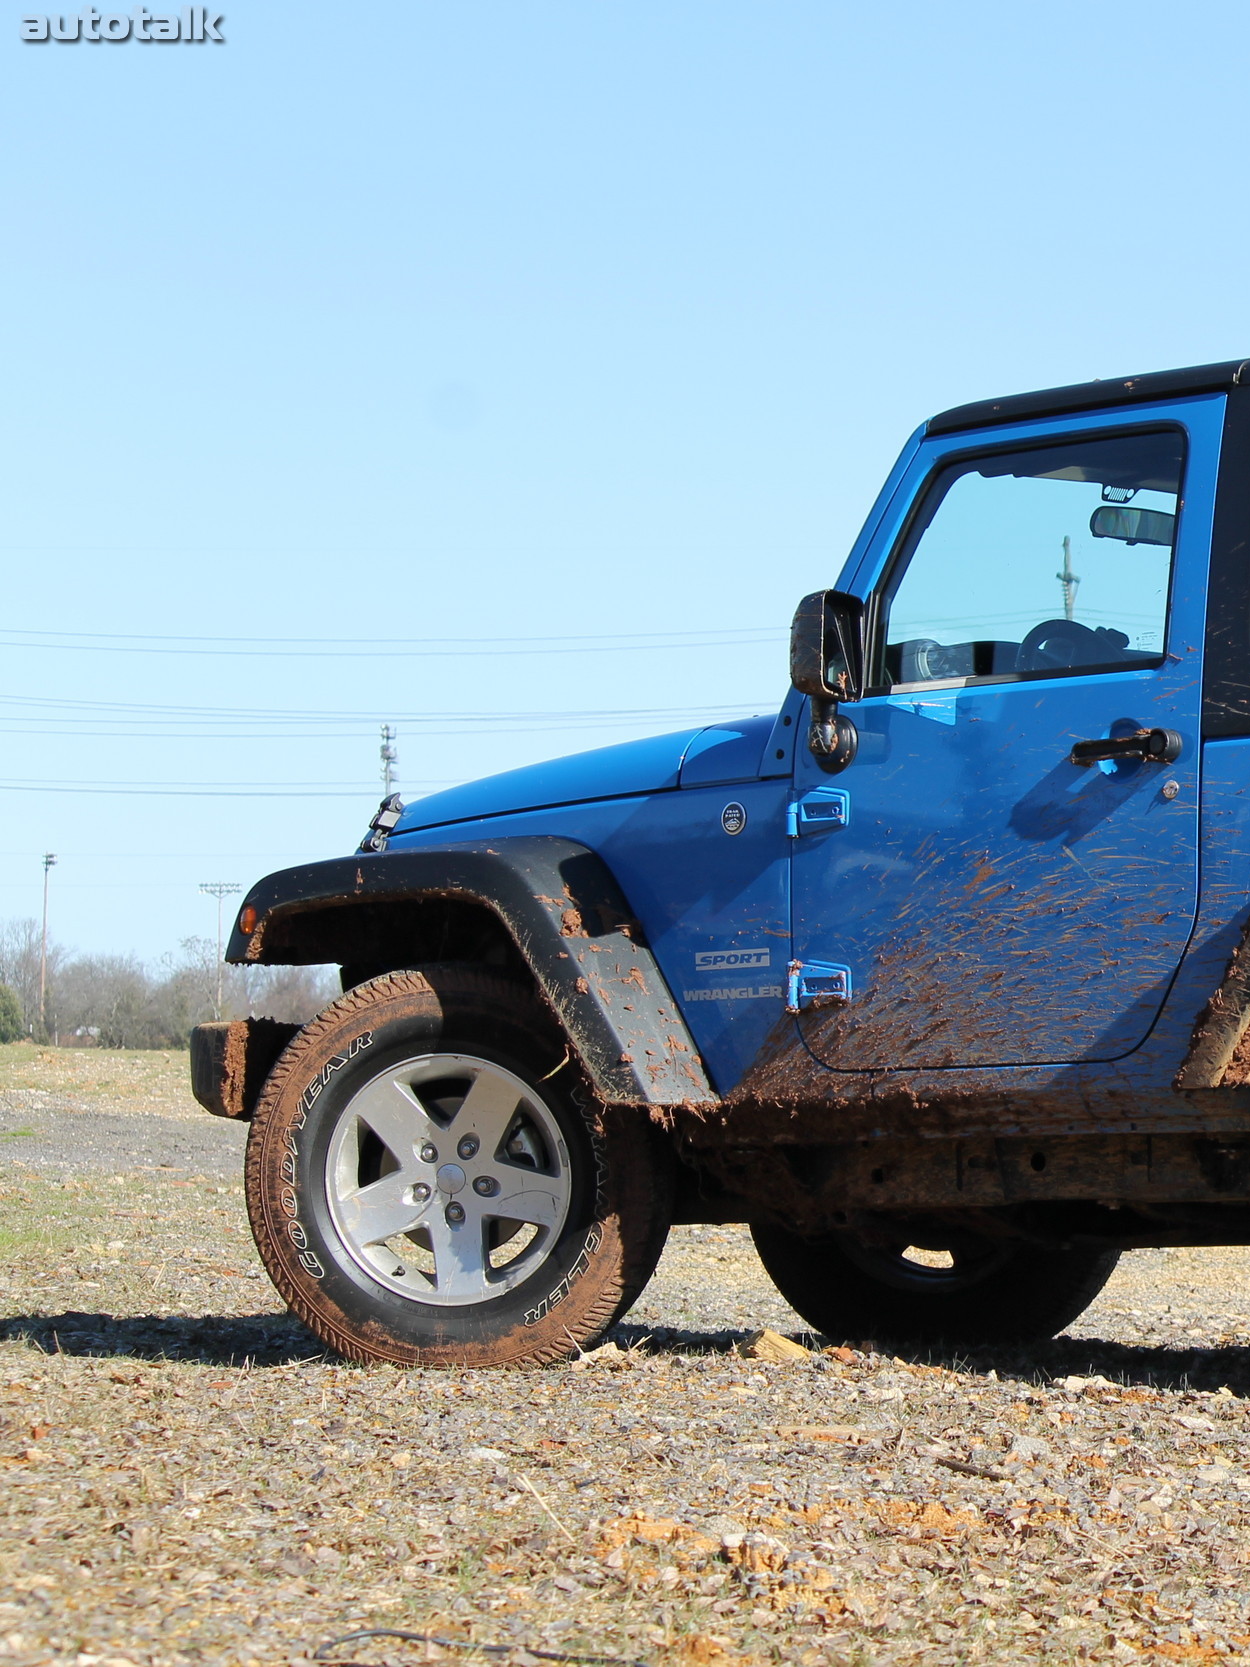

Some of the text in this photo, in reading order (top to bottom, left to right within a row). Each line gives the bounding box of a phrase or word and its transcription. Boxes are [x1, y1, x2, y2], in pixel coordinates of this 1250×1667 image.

[697, 951, 769, 968] SPORT
[682, 985, 783, 1002] WRANGLER
[279, 1030, 375, 1280] GOODYEAR
